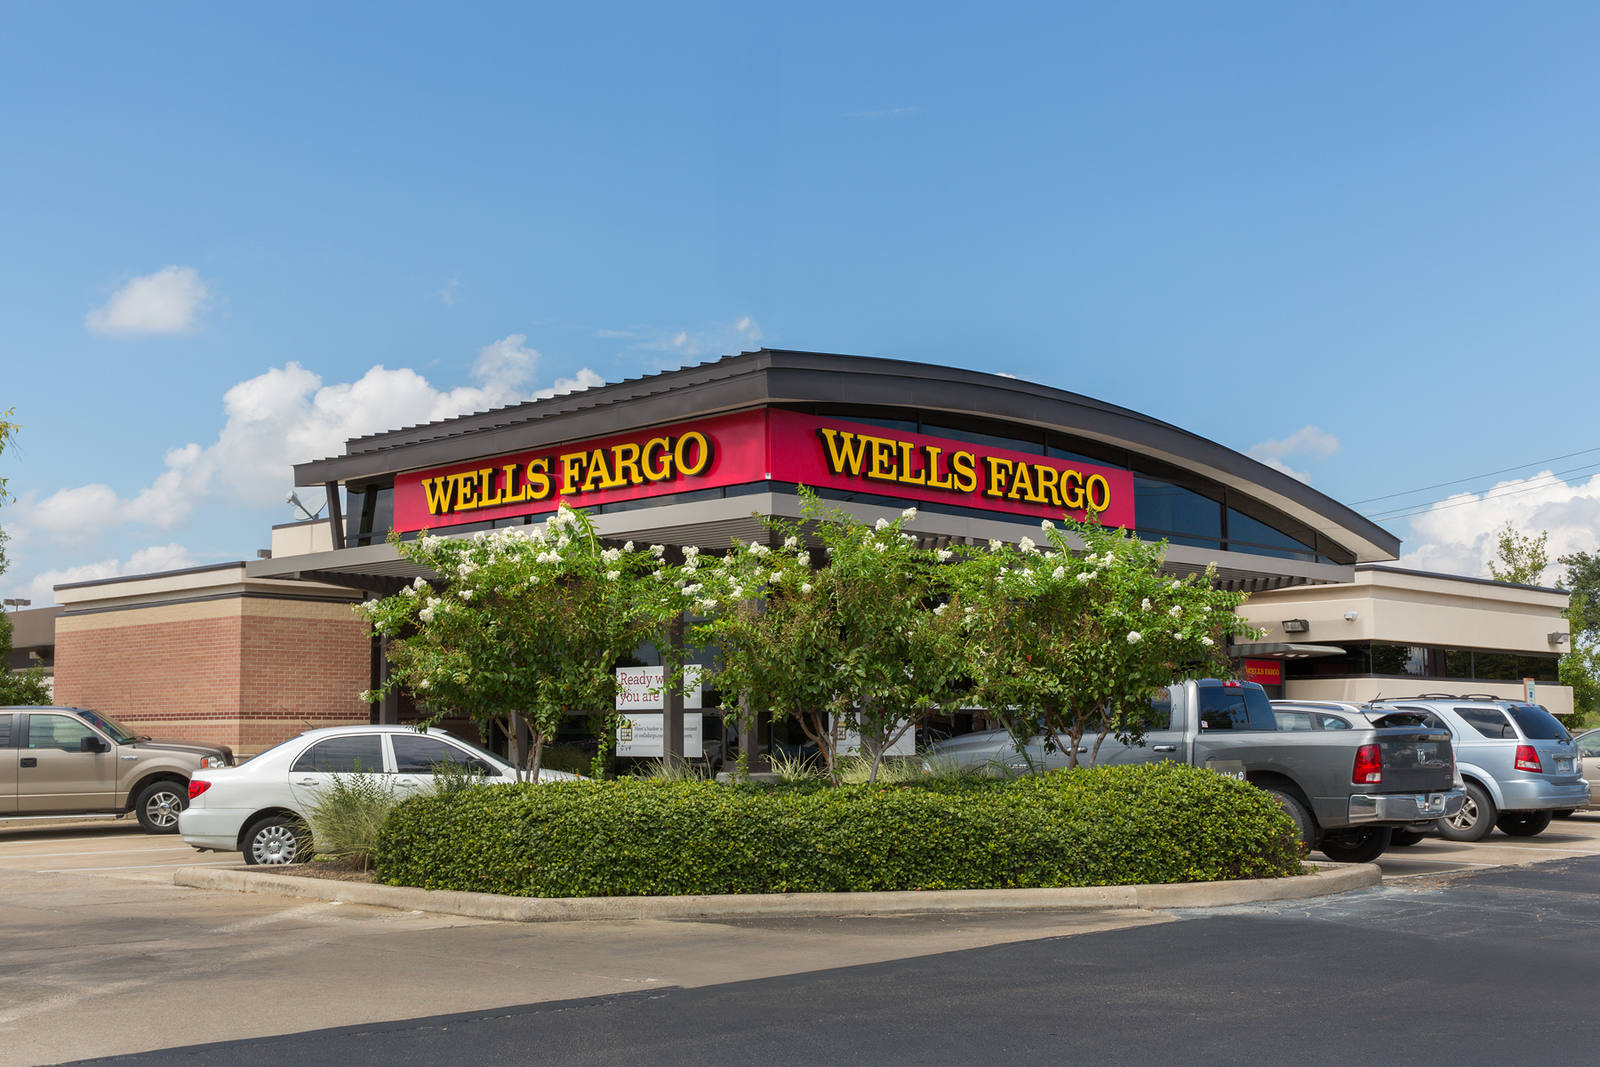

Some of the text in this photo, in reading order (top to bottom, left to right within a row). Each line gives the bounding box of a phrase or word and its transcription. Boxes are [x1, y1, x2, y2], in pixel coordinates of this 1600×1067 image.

[421, 431, 710, 515] WELLS FARGO
[820, 427, 1111, 513] WELLS FARGO
[620, 670, 652, 688] Ready
[620, 691, 659, 706] you are
